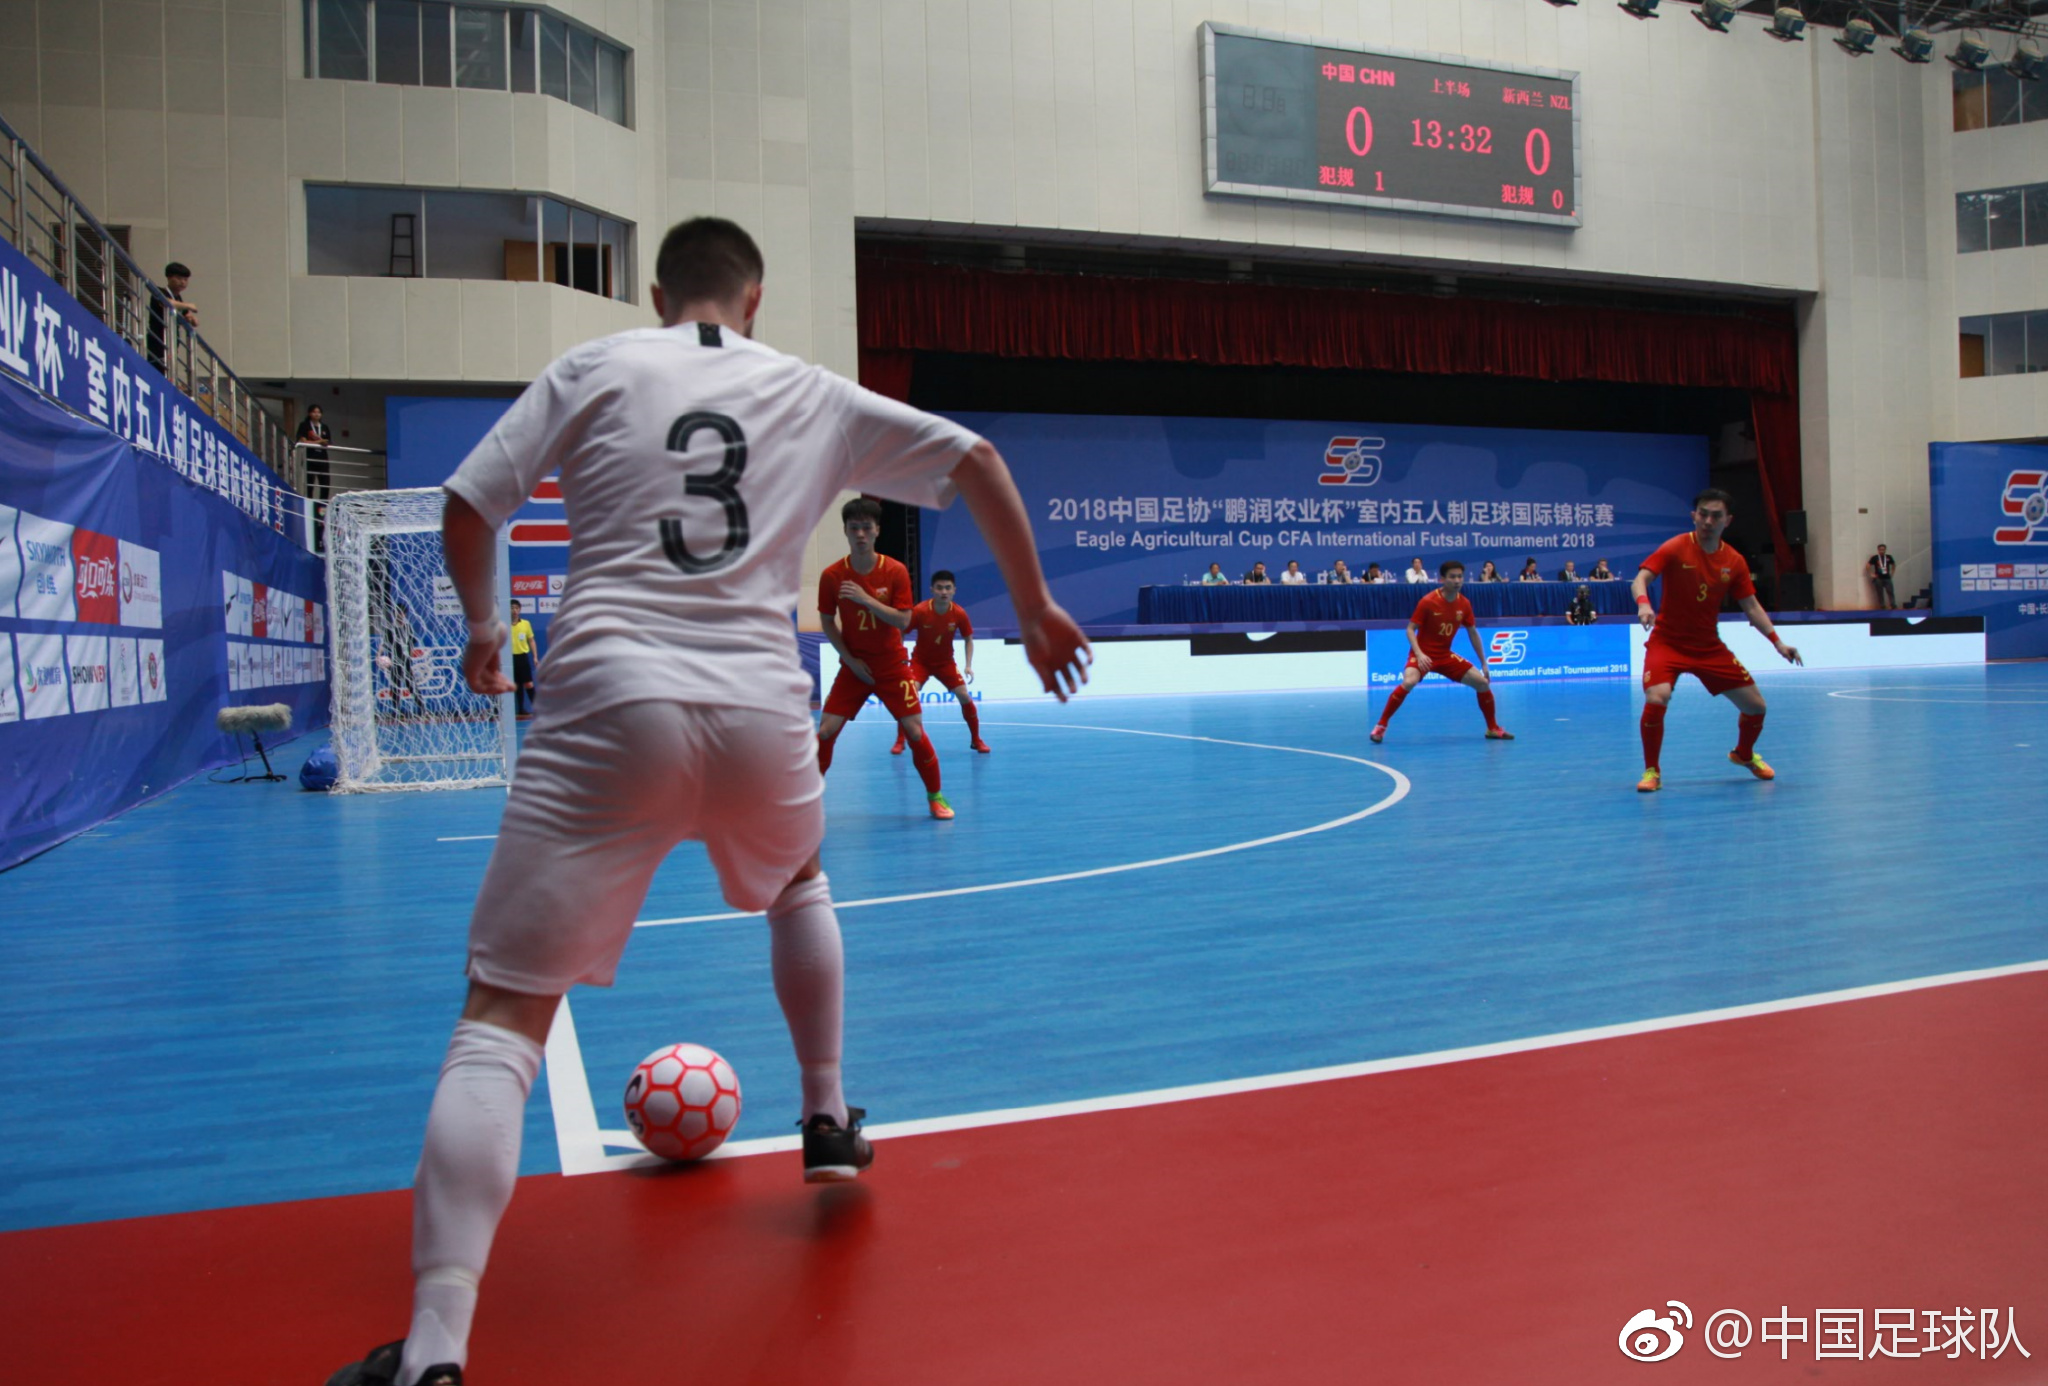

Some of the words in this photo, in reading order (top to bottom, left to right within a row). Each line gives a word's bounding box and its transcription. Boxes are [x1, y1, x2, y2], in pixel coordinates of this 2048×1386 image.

[1321, 62, 1355, 84] 中国
[1360, 67, 1396, 88] CHN
[1430, 78, 1471, 99] 上半场
[1502, 87, 1544, 109] 新西兰
[1549, 94, 1573, 111] NZL
[1345, 106, 1374, 157] 0
[1410, 118, 1494, 155] 13:32
[1524, 127, 1551, 176] 0
[1318, 165, 1355, 189] 犯规
[1374, 170, 1385, 192] 1
[1501, 183, 1534, 207] 犯规
[1552, 189, 1564, 210] 0
[659, 410, 750, 575] 3
[1076, 530, 1126, 551] Eagle
[1131, 530, 1233, 551] Agricultural
[1238, 530, 1274, 550] Cup
[1277, 530, 1313, 547] CFA
[1317, 531, 1416, 547] International
[1420, 532, 1468, 548] Futsal
[1471, 532, 1559, 548] Tournament
[1562, 533, 1596, 548] 2018
[1696, 583, 1708, 602] 3
[857, 609, 877, 631] 21
[1438, 622, 1454, 636] 20
[1371, 672, 1397, 683] Eagle
[1488, 667, 1536, 678] nternational
[1537, 665, 1562, 676] Futsal
[1563, 664, 1609, 675] Tournament
[1610, 664, 1628, 673] 2018
